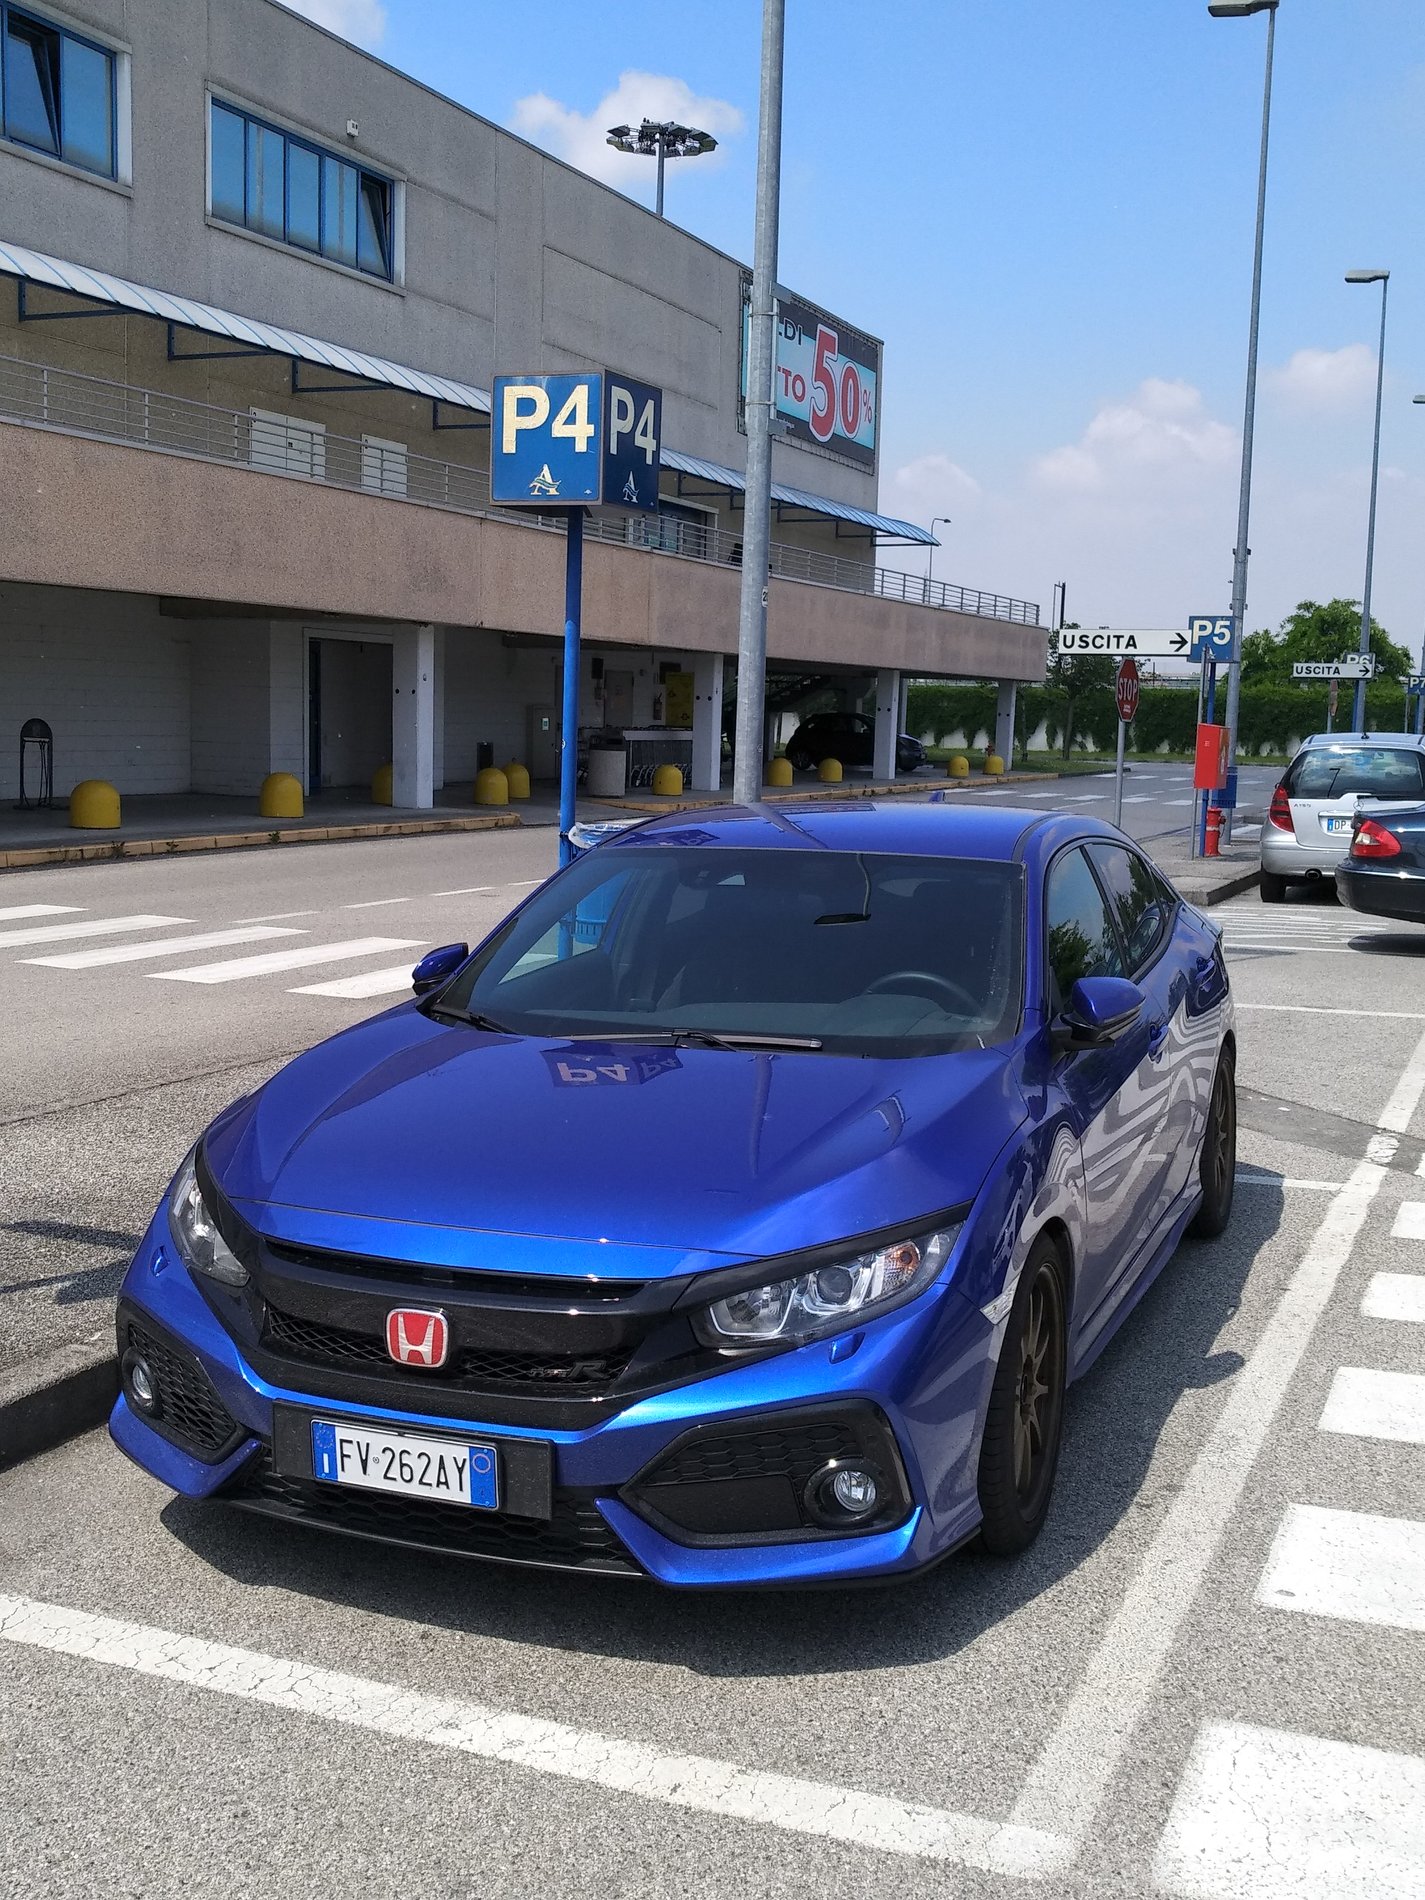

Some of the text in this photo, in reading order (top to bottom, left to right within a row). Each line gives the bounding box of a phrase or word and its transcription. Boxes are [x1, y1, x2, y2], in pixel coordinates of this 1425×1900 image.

[778, 317, 803, 346] DI
[777, 365, 806, 403] TO
[502, 384, 595, 454] P4
[610, 385, 657, 466] P4
[1062, 634, 1138, 650] USCITA
[1192, 620, 1231, 646] P5
[1295, 665, 1341, 676] USCITA
[1118, 677, 1138, 702] STOP
[1334, 820, 1347, 830] DP
